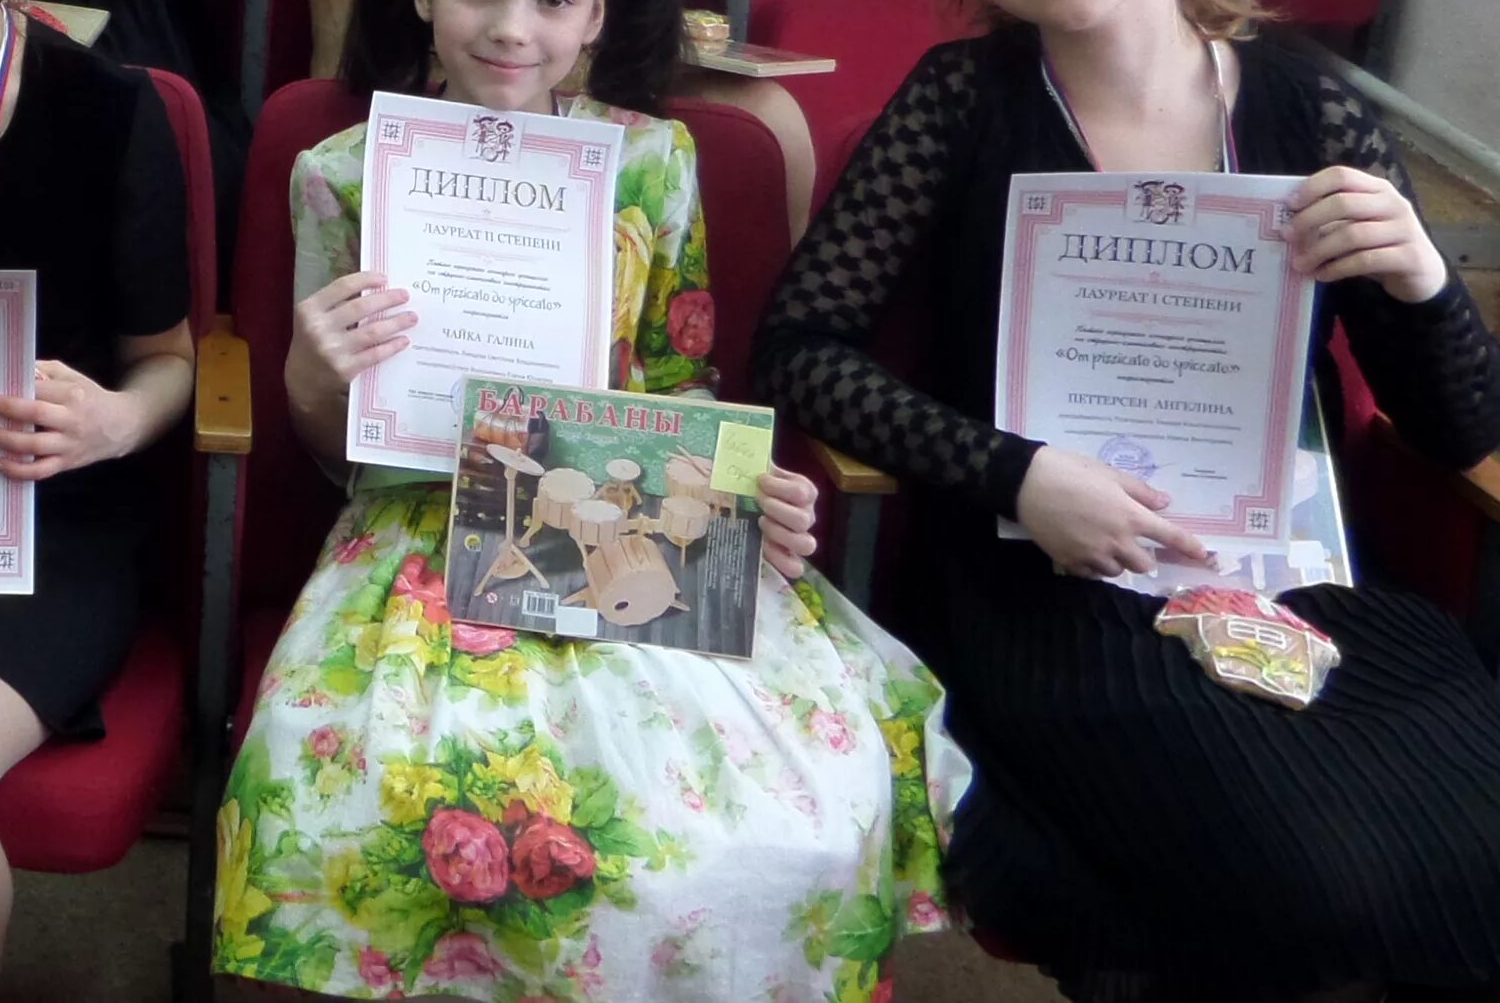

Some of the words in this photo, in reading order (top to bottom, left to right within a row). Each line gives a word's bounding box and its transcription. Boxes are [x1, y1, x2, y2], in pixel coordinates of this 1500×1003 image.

[408, 167, 567, 212] ДИПЛОМ
[423, 222, 482, 240] ЛАУРЕАТ
[497, 232, 561, 251] СТЕПЕНИ
[1058, 233, 1255, 274] ДИПЛОМ
[1076, 286, 1149, 304] ЛАУРЕАТ
[1162, 294, 1242, 313] СТЕПЕНИ
[442, 327, 482, 344] ЧАЙКА
[487, 332, 535, 350] ГАЛИНА
[477, 388, 684, 436] БАРАБАНЫ
[1154, 397, 1234, 416] АНГЕЛИНА
